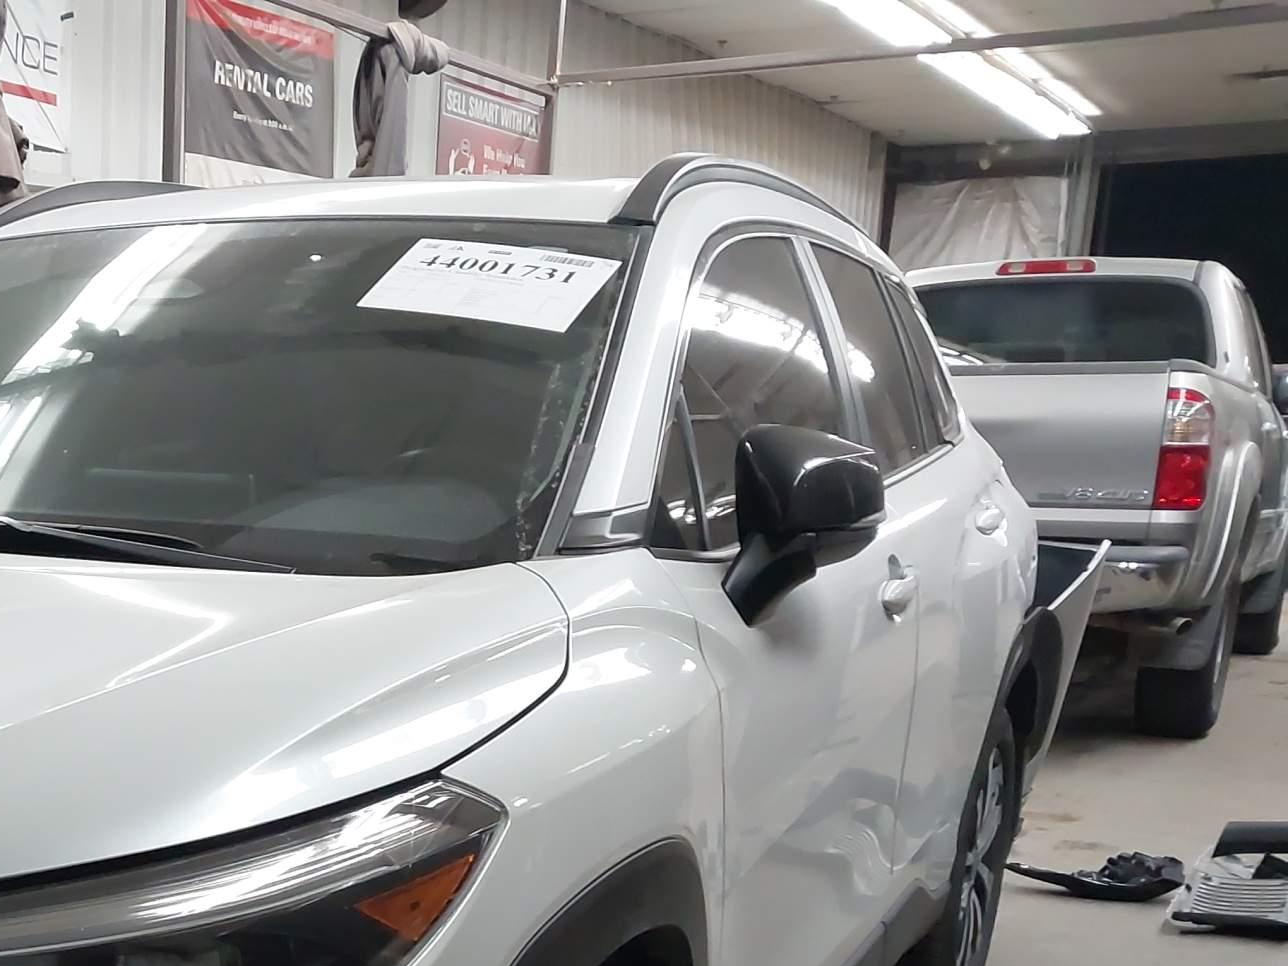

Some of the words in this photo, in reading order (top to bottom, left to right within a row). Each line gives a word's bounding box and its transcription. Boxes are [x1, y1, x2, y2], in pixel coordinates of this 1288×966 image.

[214, 60, 272, 98] RENTAL
[275, 76, 313, 108] CARS
[446, 89, 467, 115] SELL
[469, 95, 500, 126] SMART
[500, 106, 523, 133] WITH
[420, 255, 577, 284] 44001731
